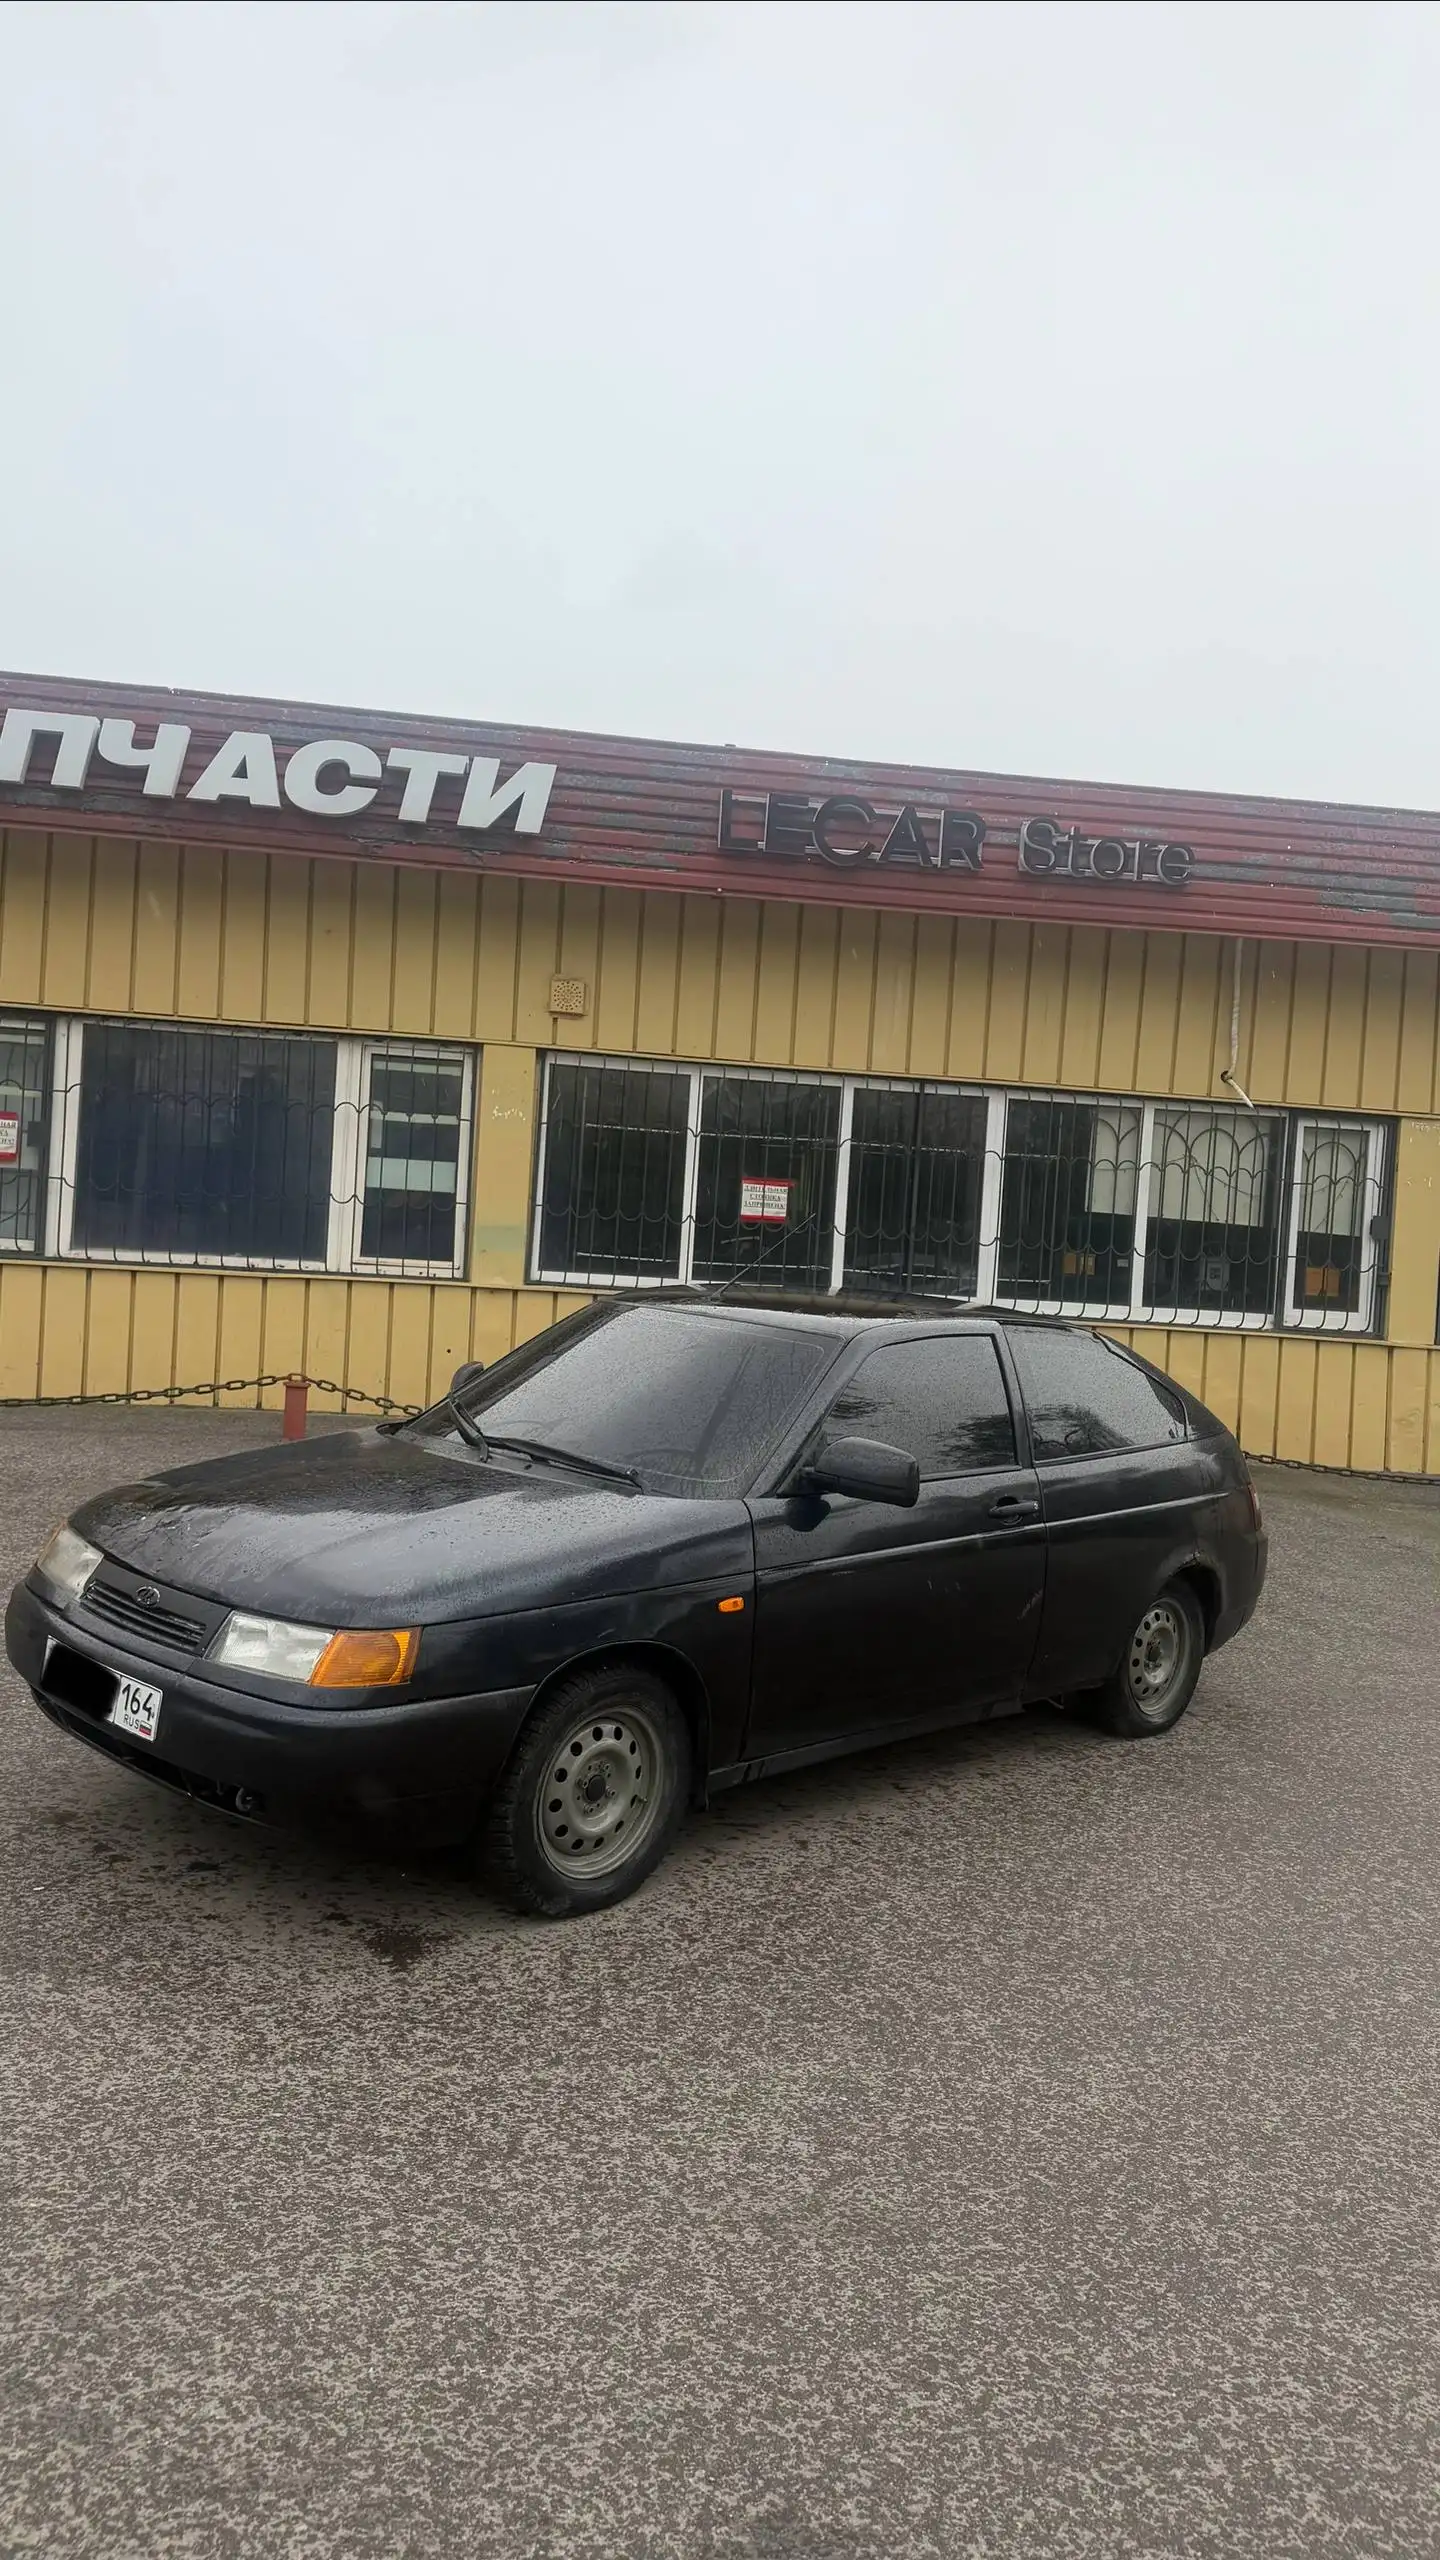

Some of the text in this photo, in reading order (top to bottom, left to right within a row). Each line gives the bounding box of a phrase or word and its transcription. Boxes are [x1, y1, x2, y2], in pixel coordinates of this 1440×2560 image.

[718, 789, 1196, 885] LECAR Store
[122, 1683, 153, 1721] 164
[123, 1713, 140, 1730] RUS
